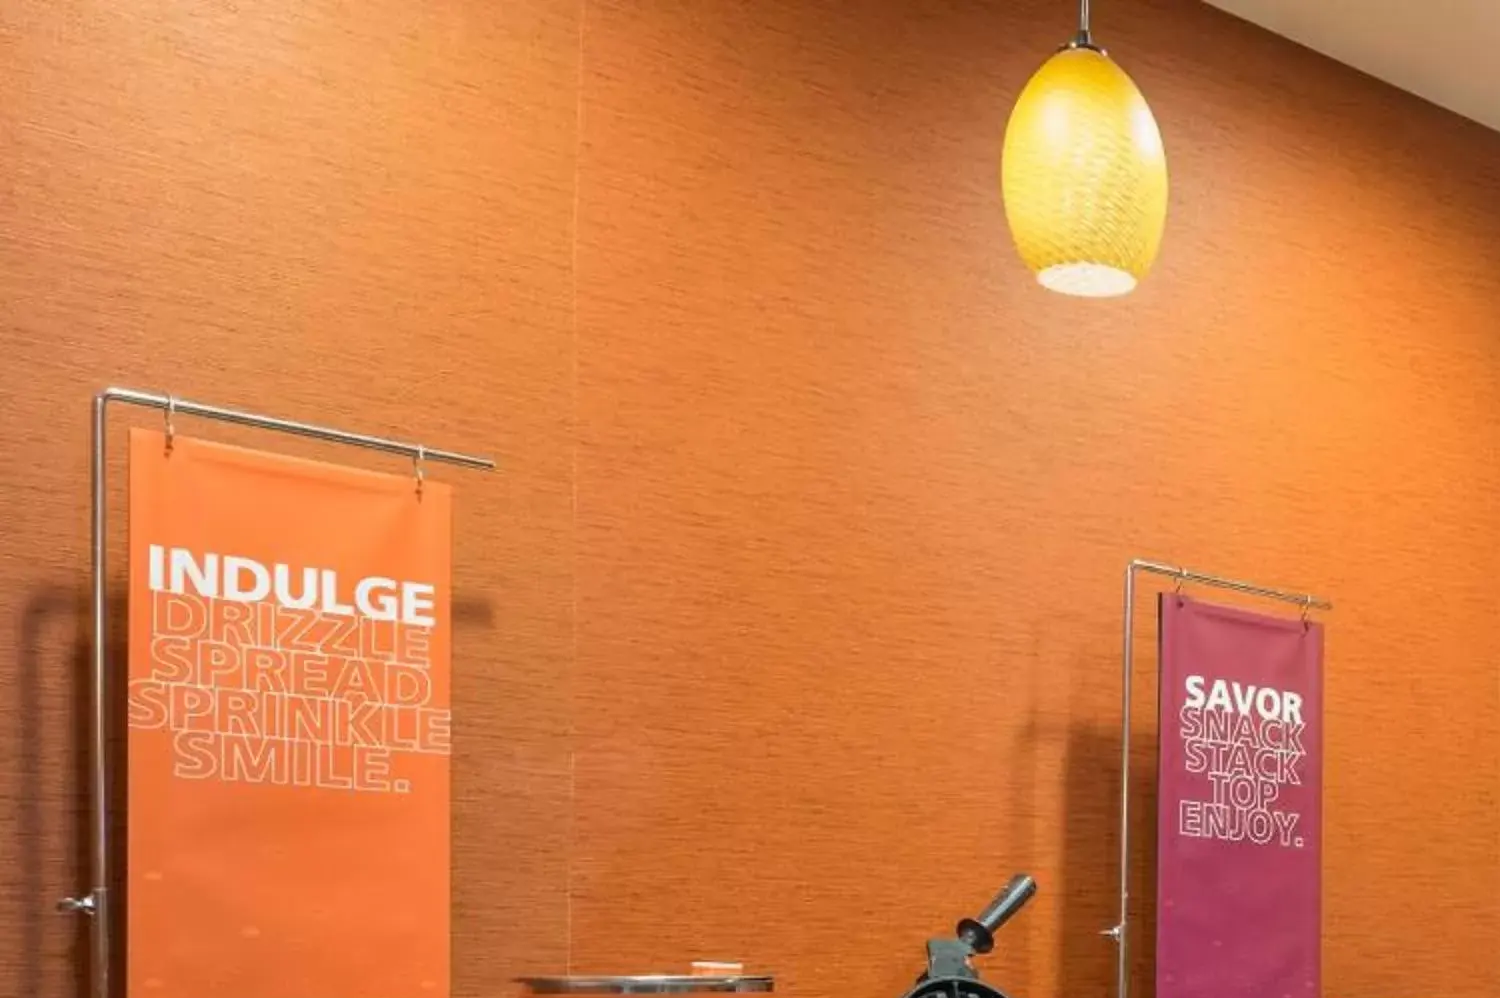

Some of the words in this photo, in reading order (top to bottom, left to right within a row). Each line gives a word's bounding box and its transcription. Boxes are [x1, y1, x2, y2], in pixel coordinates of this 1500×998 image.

[149, 543, 435, 627] INDULGE
[153, 590, 431, 668] DRIZZLE
[150, 636, 432, 707] SPREAD
[1185, 674, 1302, 724] SAVOR
[127, 677, 451, 755] SPRINKLE
[1180, 704, 1306, 755] SNACK
[173, 729, 411, 794] SMILE.
[1185, 736, 1302, 785] STACK
[1208, 771, 1279, 812] TOP
[1179, 799, 1304, 847] ENJOY.
